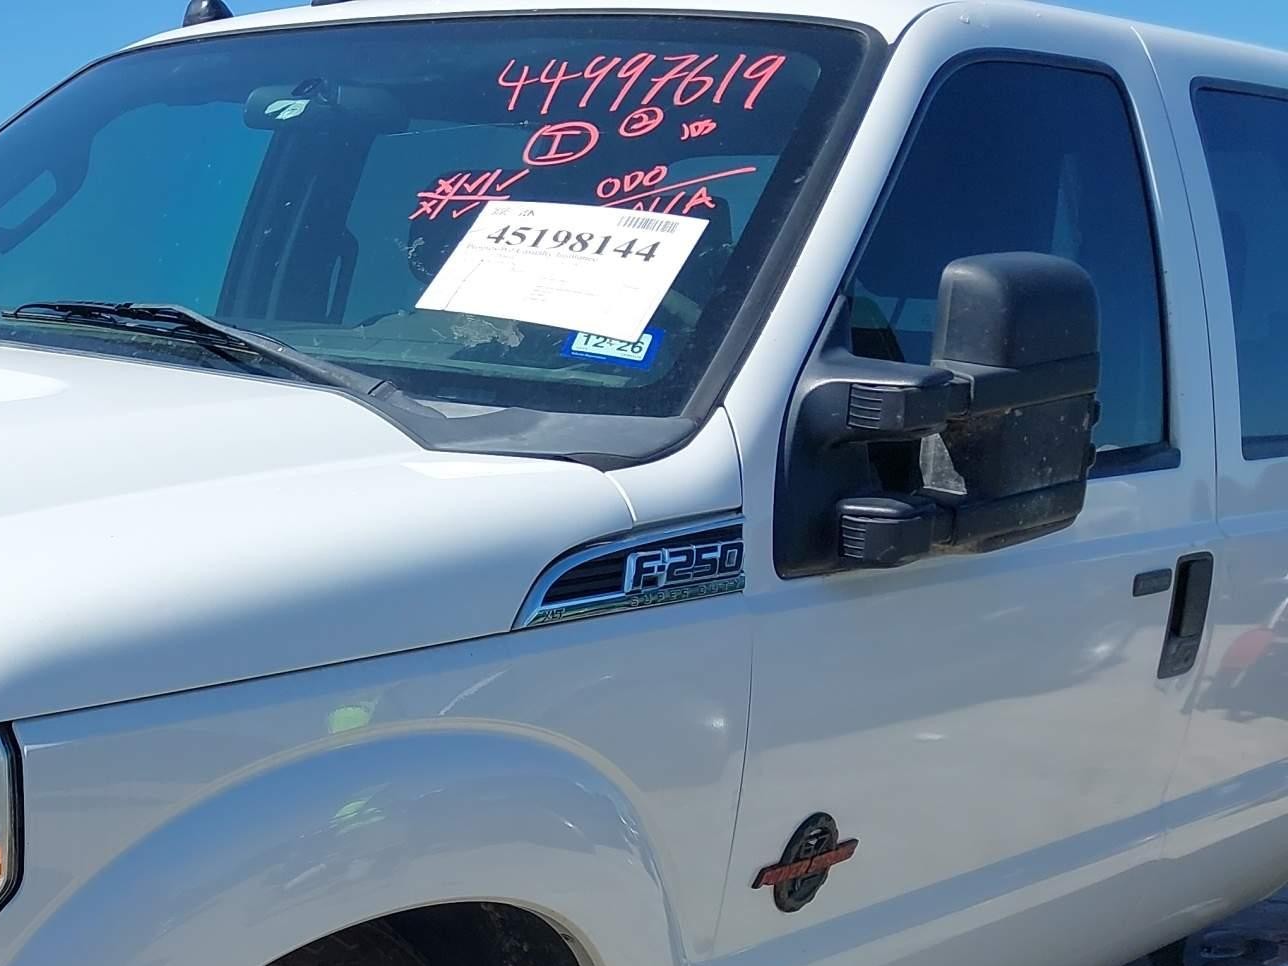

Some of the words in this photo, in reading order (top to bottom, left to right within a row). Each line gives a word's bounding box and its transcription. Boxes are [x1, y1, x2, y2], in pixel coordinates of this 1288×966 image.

[596, 165, 668, 198] ODO
[487, 224, 661, 262] 45198144
[625, 539, 745, 594] F-250
